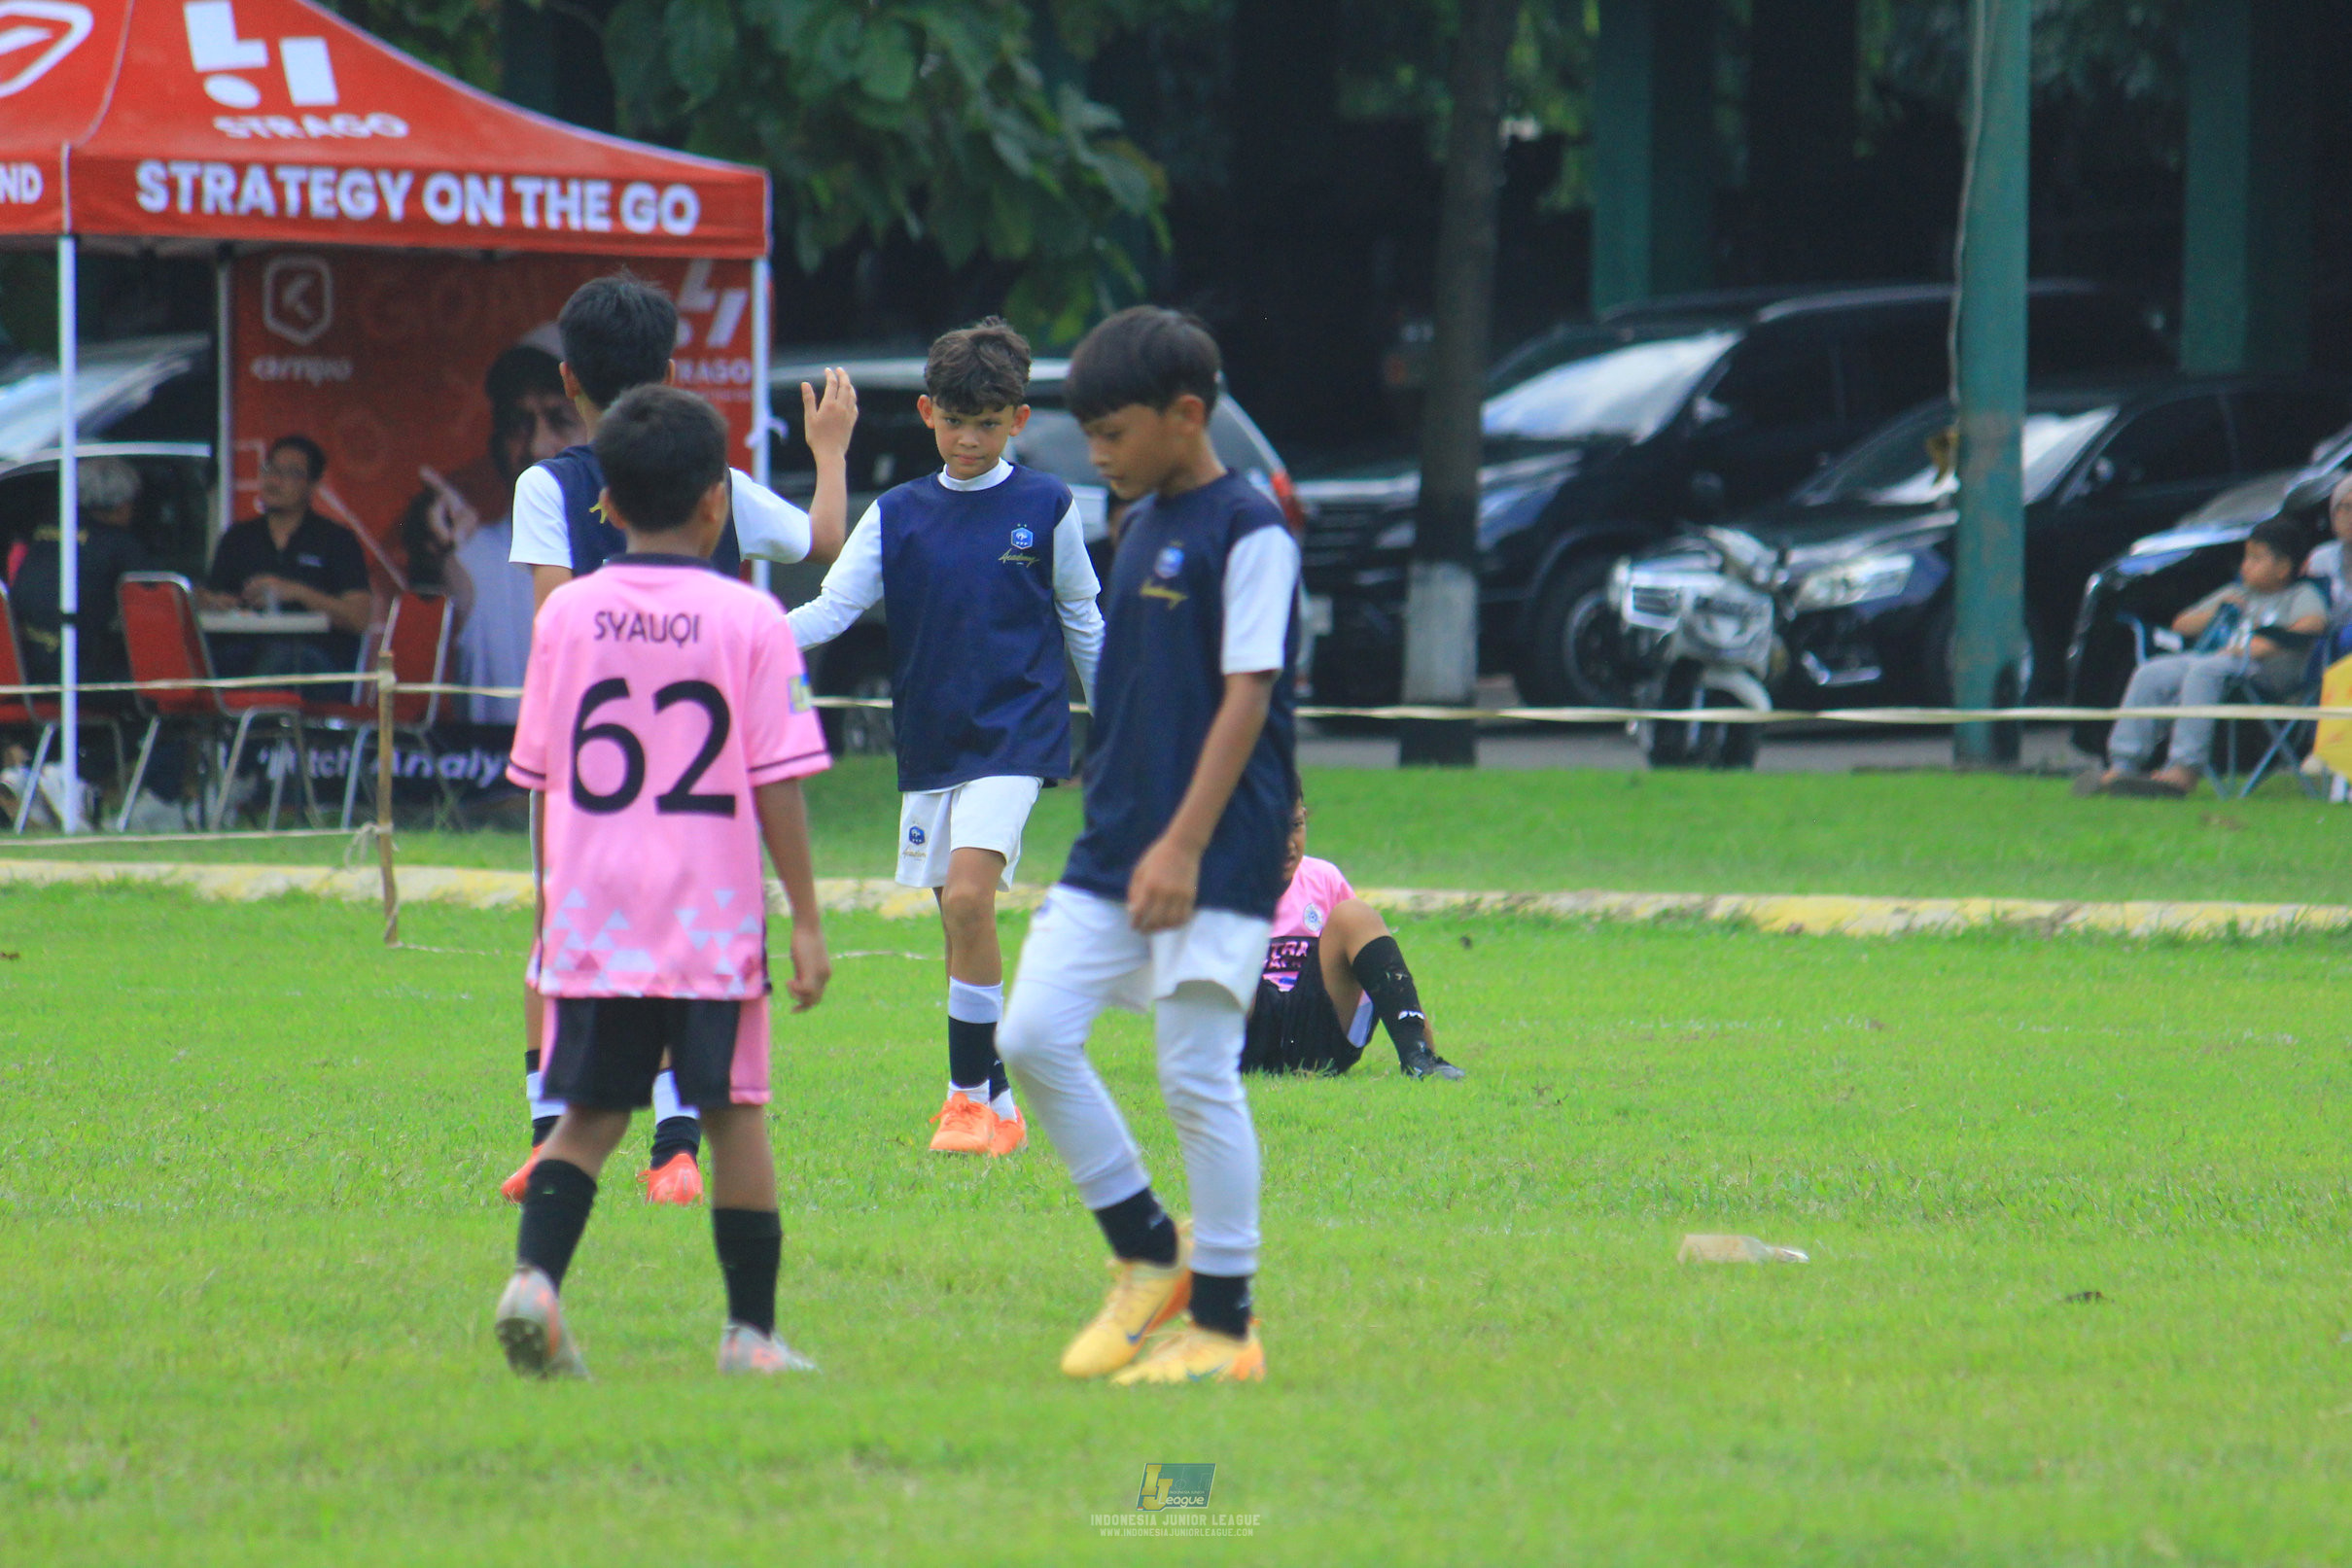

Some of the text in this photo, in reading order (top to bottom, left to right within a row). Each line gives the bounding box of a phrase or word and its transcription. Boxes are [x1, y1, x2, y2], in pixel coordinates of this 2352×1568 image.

[212, 112, 409, 139] STRAGO
[135, 159, 701, 236] STRATEGY ON THE GO
[594, 610, 700, 648] SYAUQI
[570, 677, 736, 819] 62
